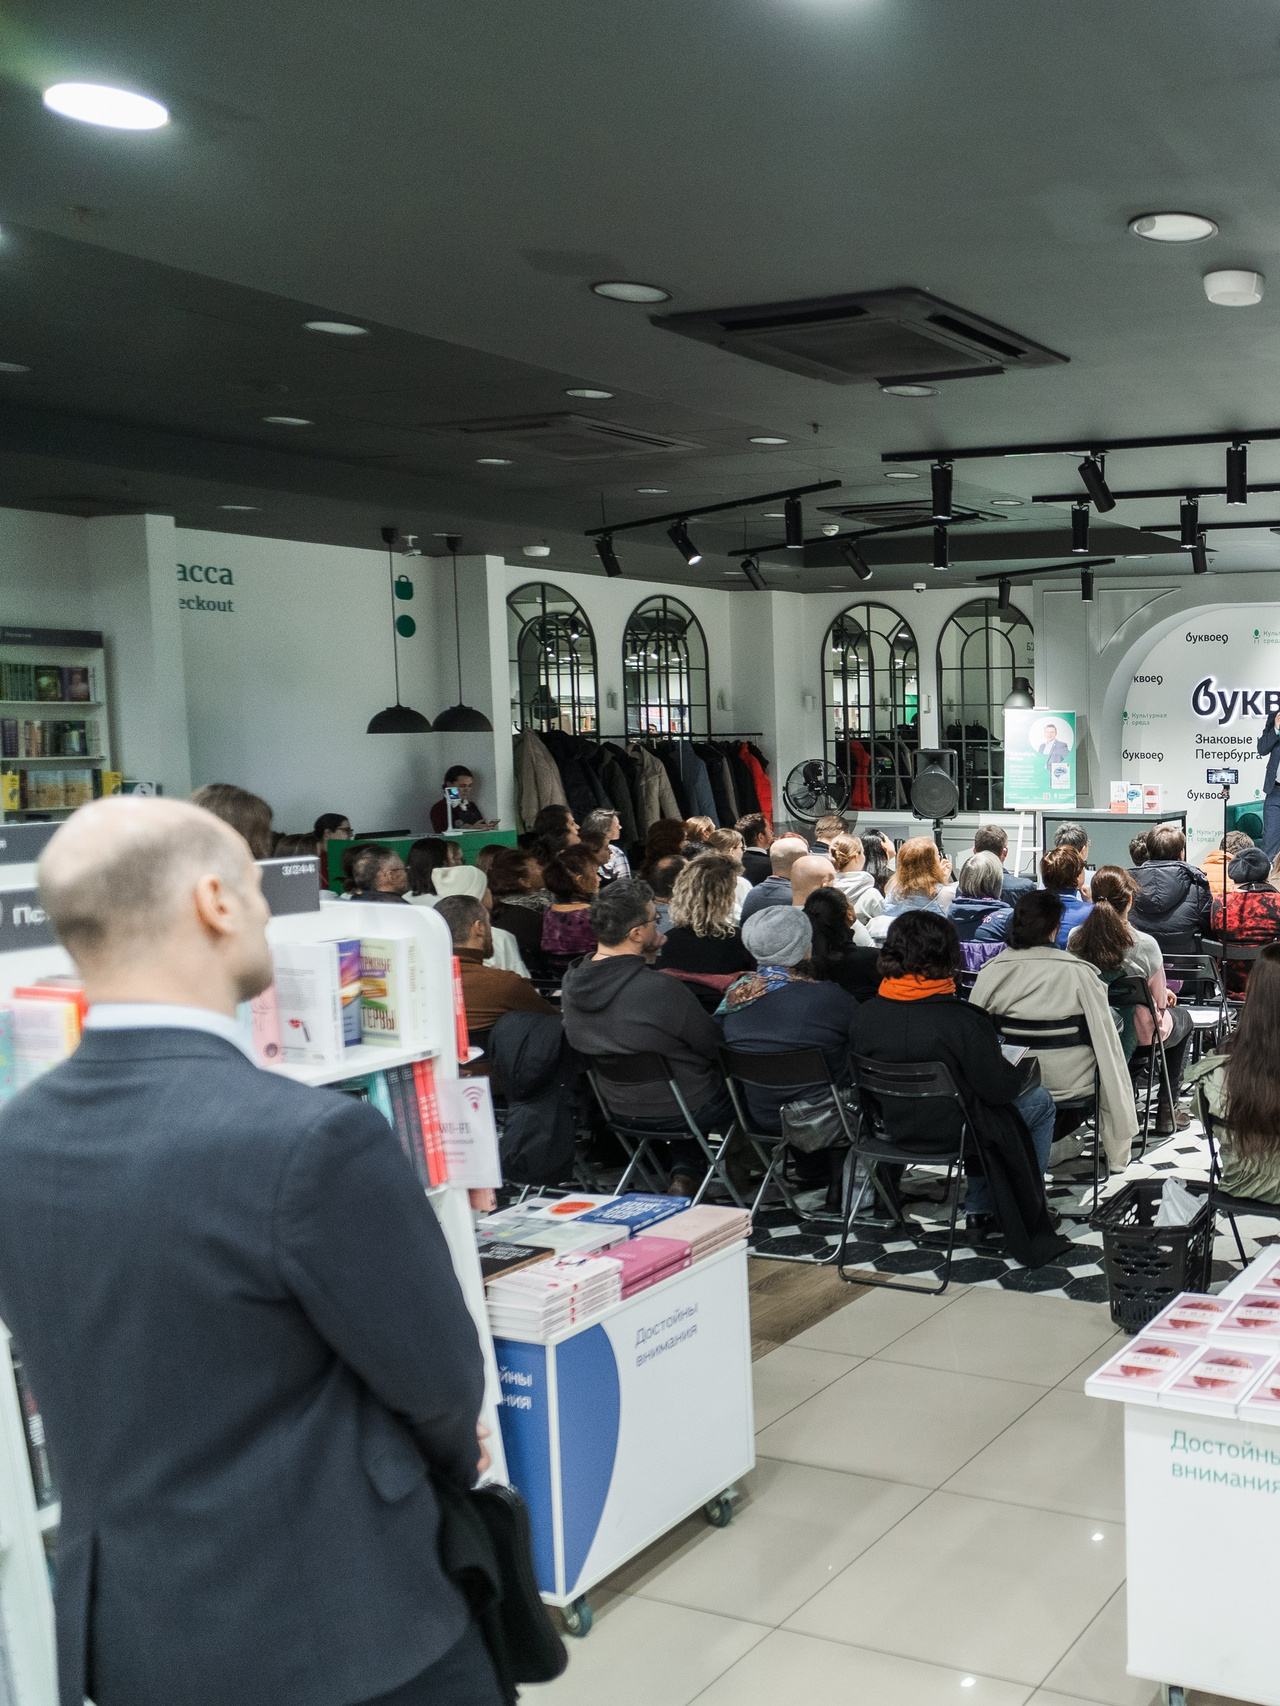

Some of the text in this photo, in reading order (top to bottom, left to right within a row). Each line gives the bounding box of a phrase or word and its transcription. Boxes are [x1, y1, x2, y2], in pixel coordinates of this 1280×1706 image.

[177, 563, 234, 586] асса
[1185, 632, 1229, 645] буквоед
[1195, 733, 1253, 745] Знаковые
[1122, 749, 1164, 762] буквоед
[1195, 748, 1263, 762] Петербурга
